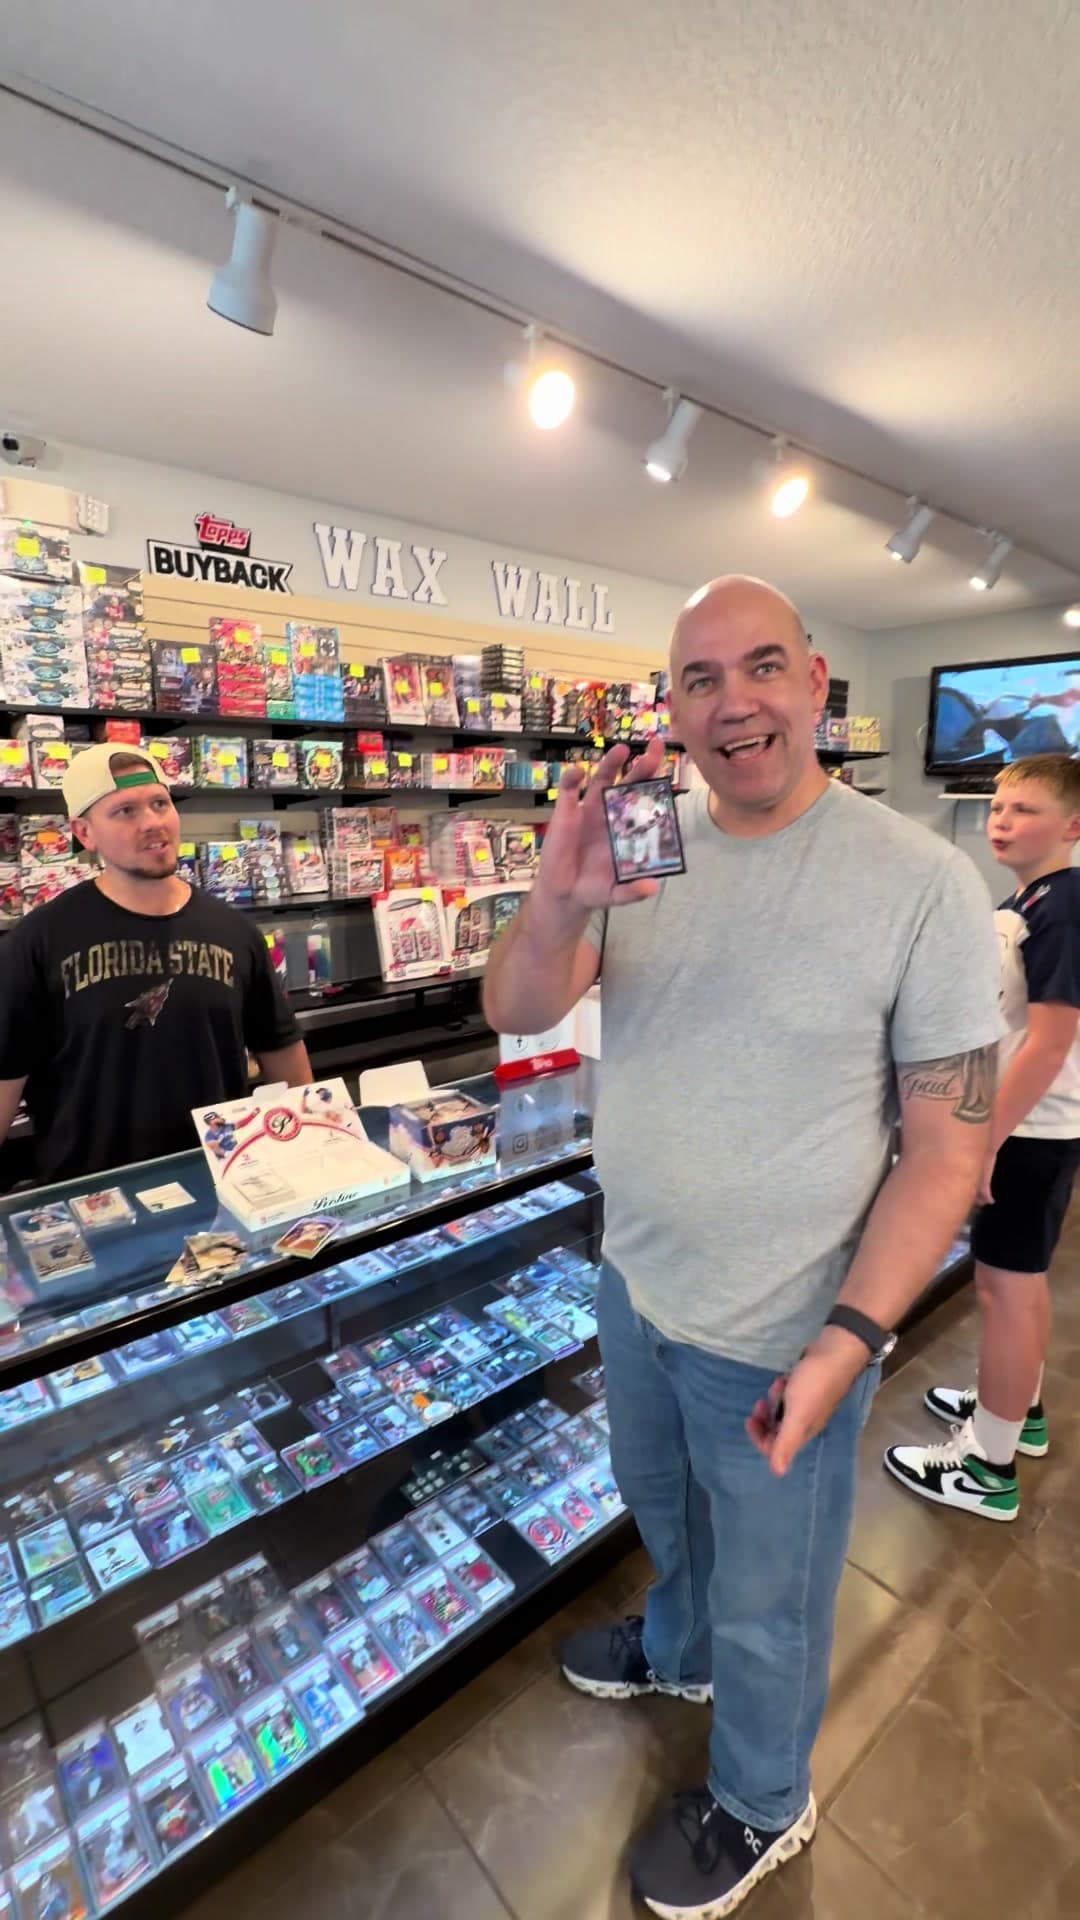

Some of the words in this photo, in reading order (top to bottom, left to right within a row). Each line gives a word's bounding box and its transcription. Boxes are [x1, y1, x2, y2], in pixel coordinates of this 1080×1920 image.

[154, 546, 286, 593] BUYBACK
[313, 521, 448, 606] WAX
[490, 559, 615, 634] WALL
[60, 939, 164, 999] FLORIDA
[169, 939, 234, 988] STATE
